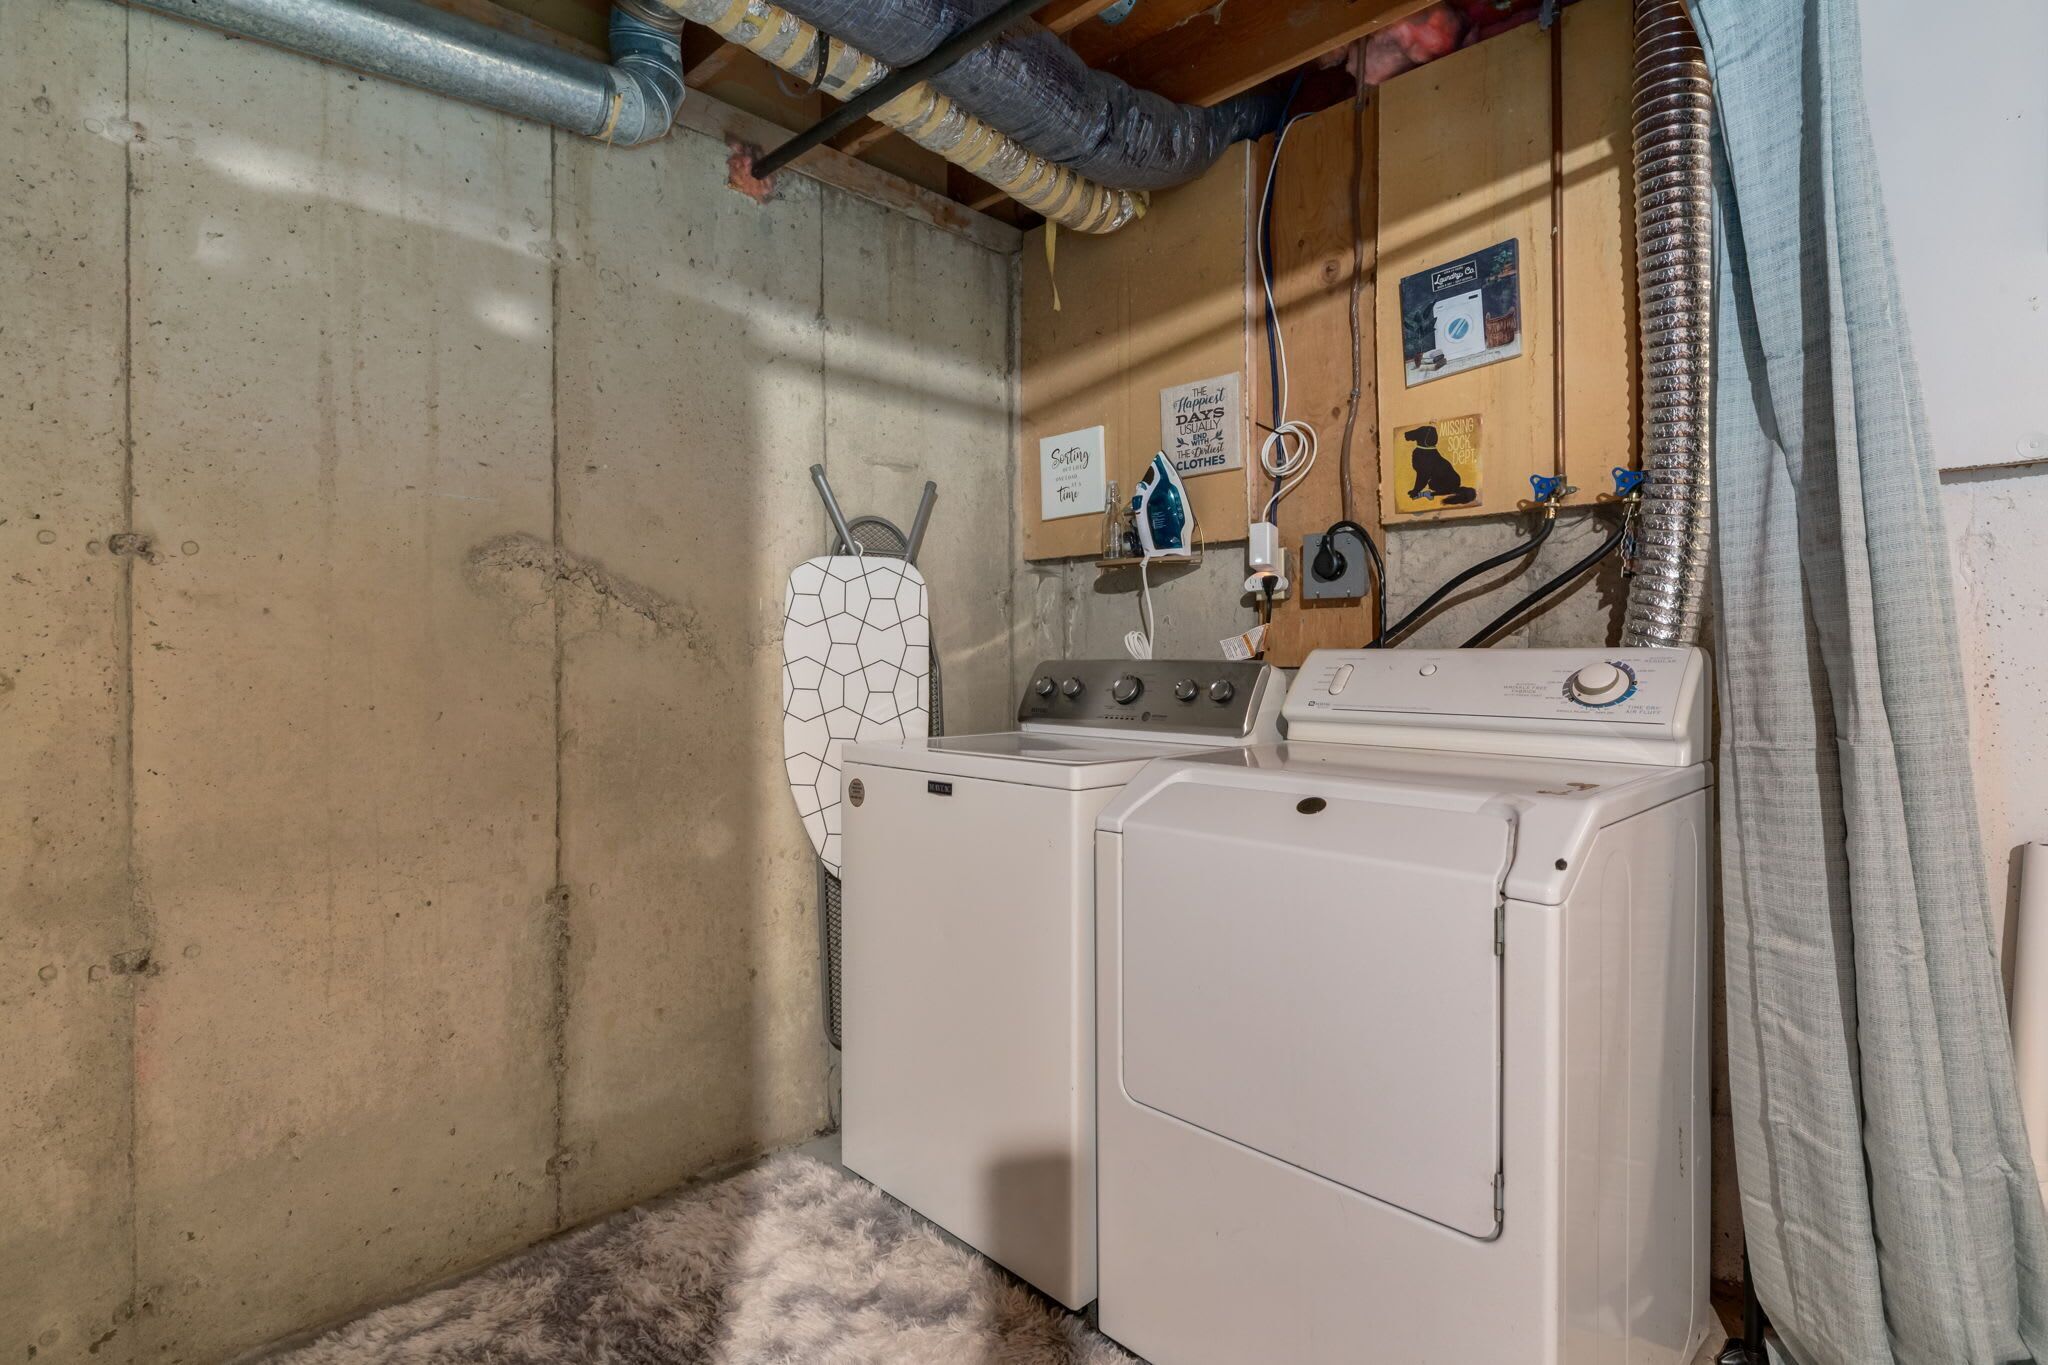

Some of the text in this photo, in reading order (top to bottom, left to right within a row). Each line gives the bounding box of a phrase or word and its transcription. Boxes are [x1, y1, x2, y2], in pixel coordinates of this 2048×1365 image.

[1434, 272, 1464, 285] Laundry
[1173, 387, 1225, 413] Happiest
[1192, 386, 1207, 397] THE
[1176, 407, 1225, 426] DAYS
[1180, 419, 1221, 436] USUALLY
[1439, 417, 1474, 437] MISSING
[1191, 438, 1209, 446] WITH
[1193, 432, 1207, 440] END
[1447, 433, 1472, 452] SOCK
[1051, 447, 1089, 470] Sorting
[1176, 442, 1225, 459] THE Dirtiest
[1176, 454, 1226, 471] CLOTHES
[1056, 486, 1080, 503] time
